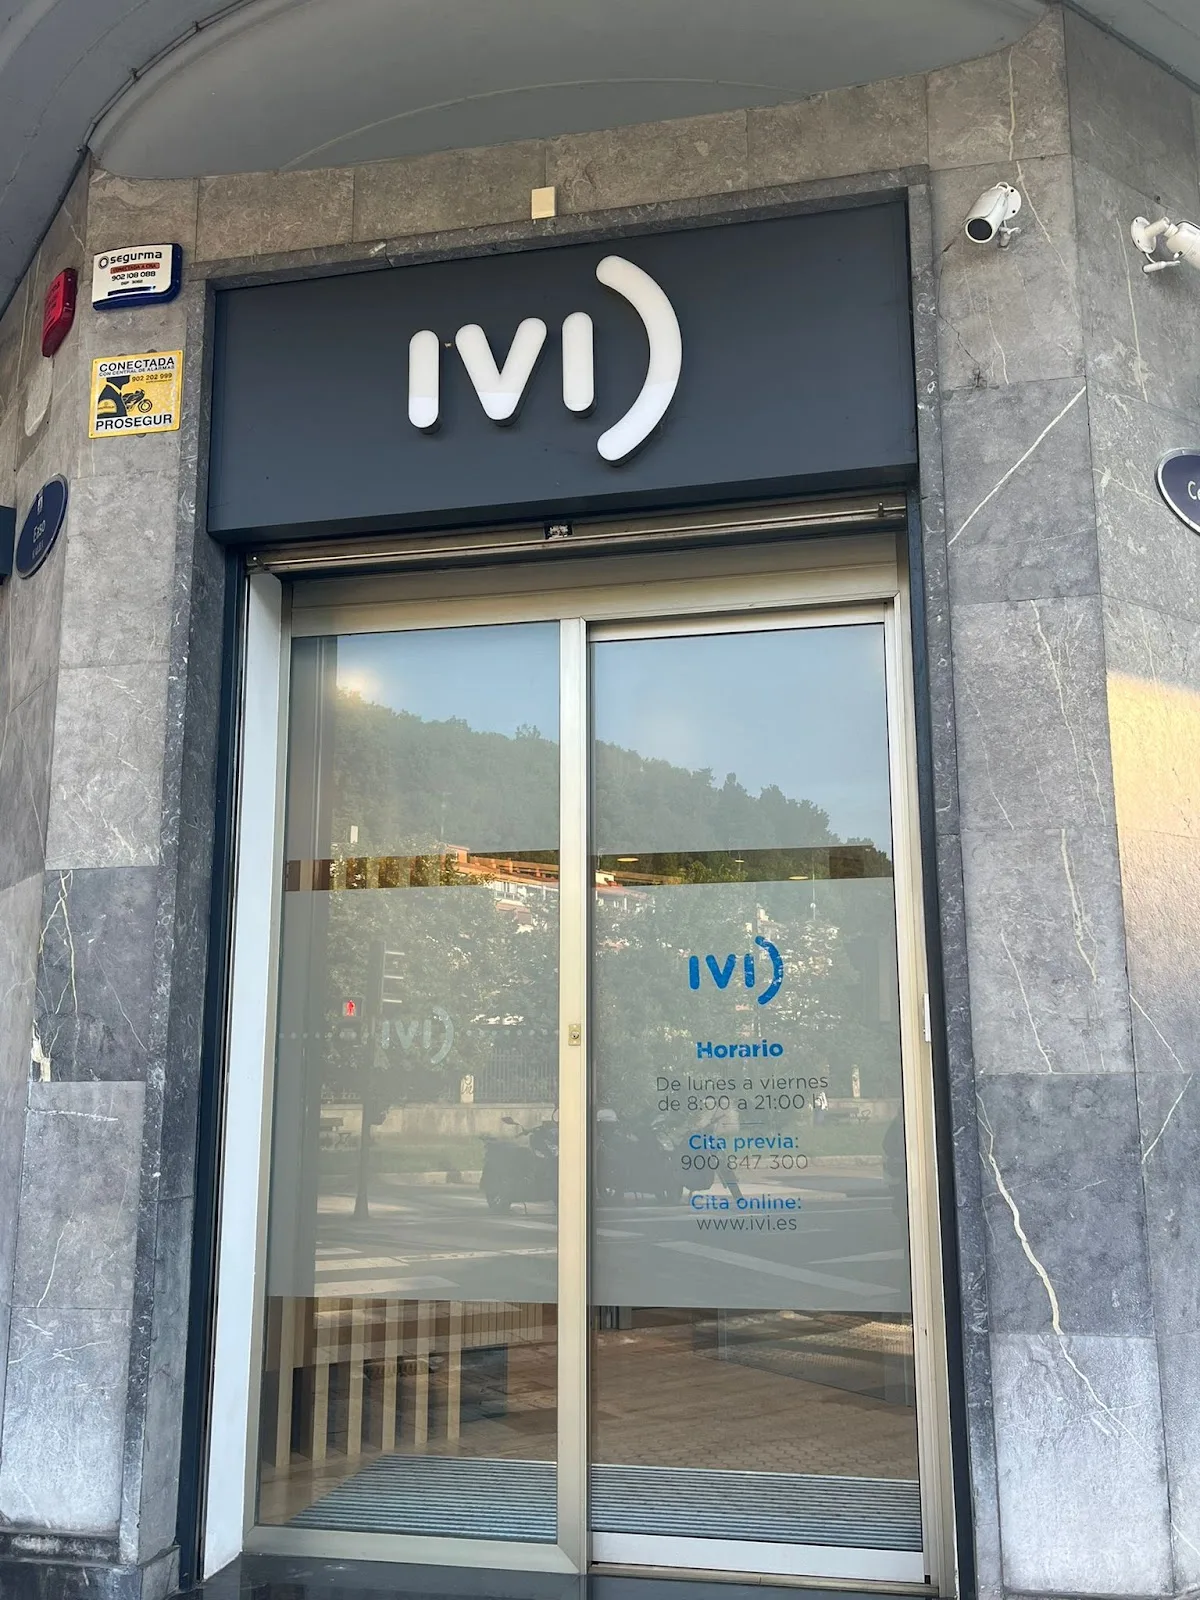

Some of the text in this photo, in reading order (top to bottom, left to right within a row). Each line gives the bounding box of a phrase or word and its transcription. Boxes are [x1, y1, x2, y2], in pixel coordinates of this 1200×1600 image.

[110, 251, 163, 264] segurma
[111, 273, 126, 281] 902
[99, 357, 175, 372] CONECTADA
[96, 413, 172, 430] PROSEGUR
[696, 1039, 784, 1059] Horario
[656, 1075, 829, 1092] De lunes a viernes
[657, 1096, 681, 1112] de
[687, 1095, 731, 1111] 8:00
[737, 1098, 748, 1110] a
[754, 1094, 805, 1110] 21:00
[689, 1133, 799, 1153] Cita previa:
[680, 1153, 809, 1171] 900 847 300
[691, 1193, 802, 1211] Cita online:
[696, 1215, 797, 1231] www.ivi.es
